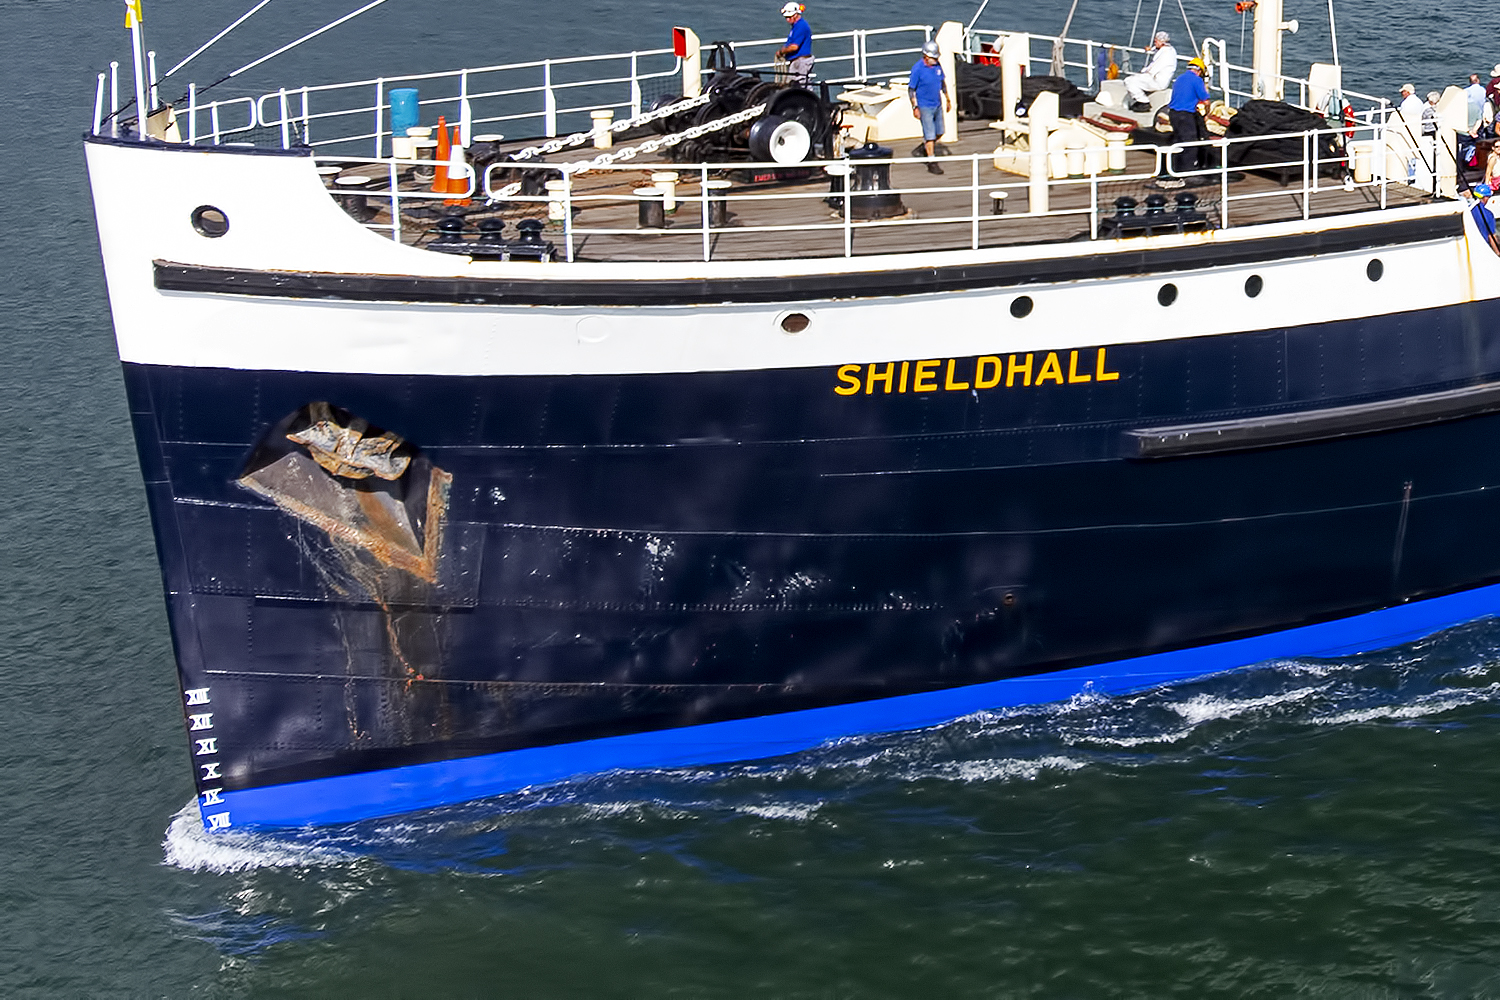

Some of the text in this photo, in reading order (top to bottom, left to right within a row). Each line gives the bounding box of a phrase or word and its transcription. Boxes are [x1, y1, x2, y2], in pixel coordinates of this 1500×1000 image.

[834, 347, 1120, 396] SHIELDHALL
[184, 687, 211, 706] XIII
[188, 713, 214, 731] XII
[194, 737, 219, 756] XI
[200, 762, 222, 781] X
[201, 787, 225, 807] IX
